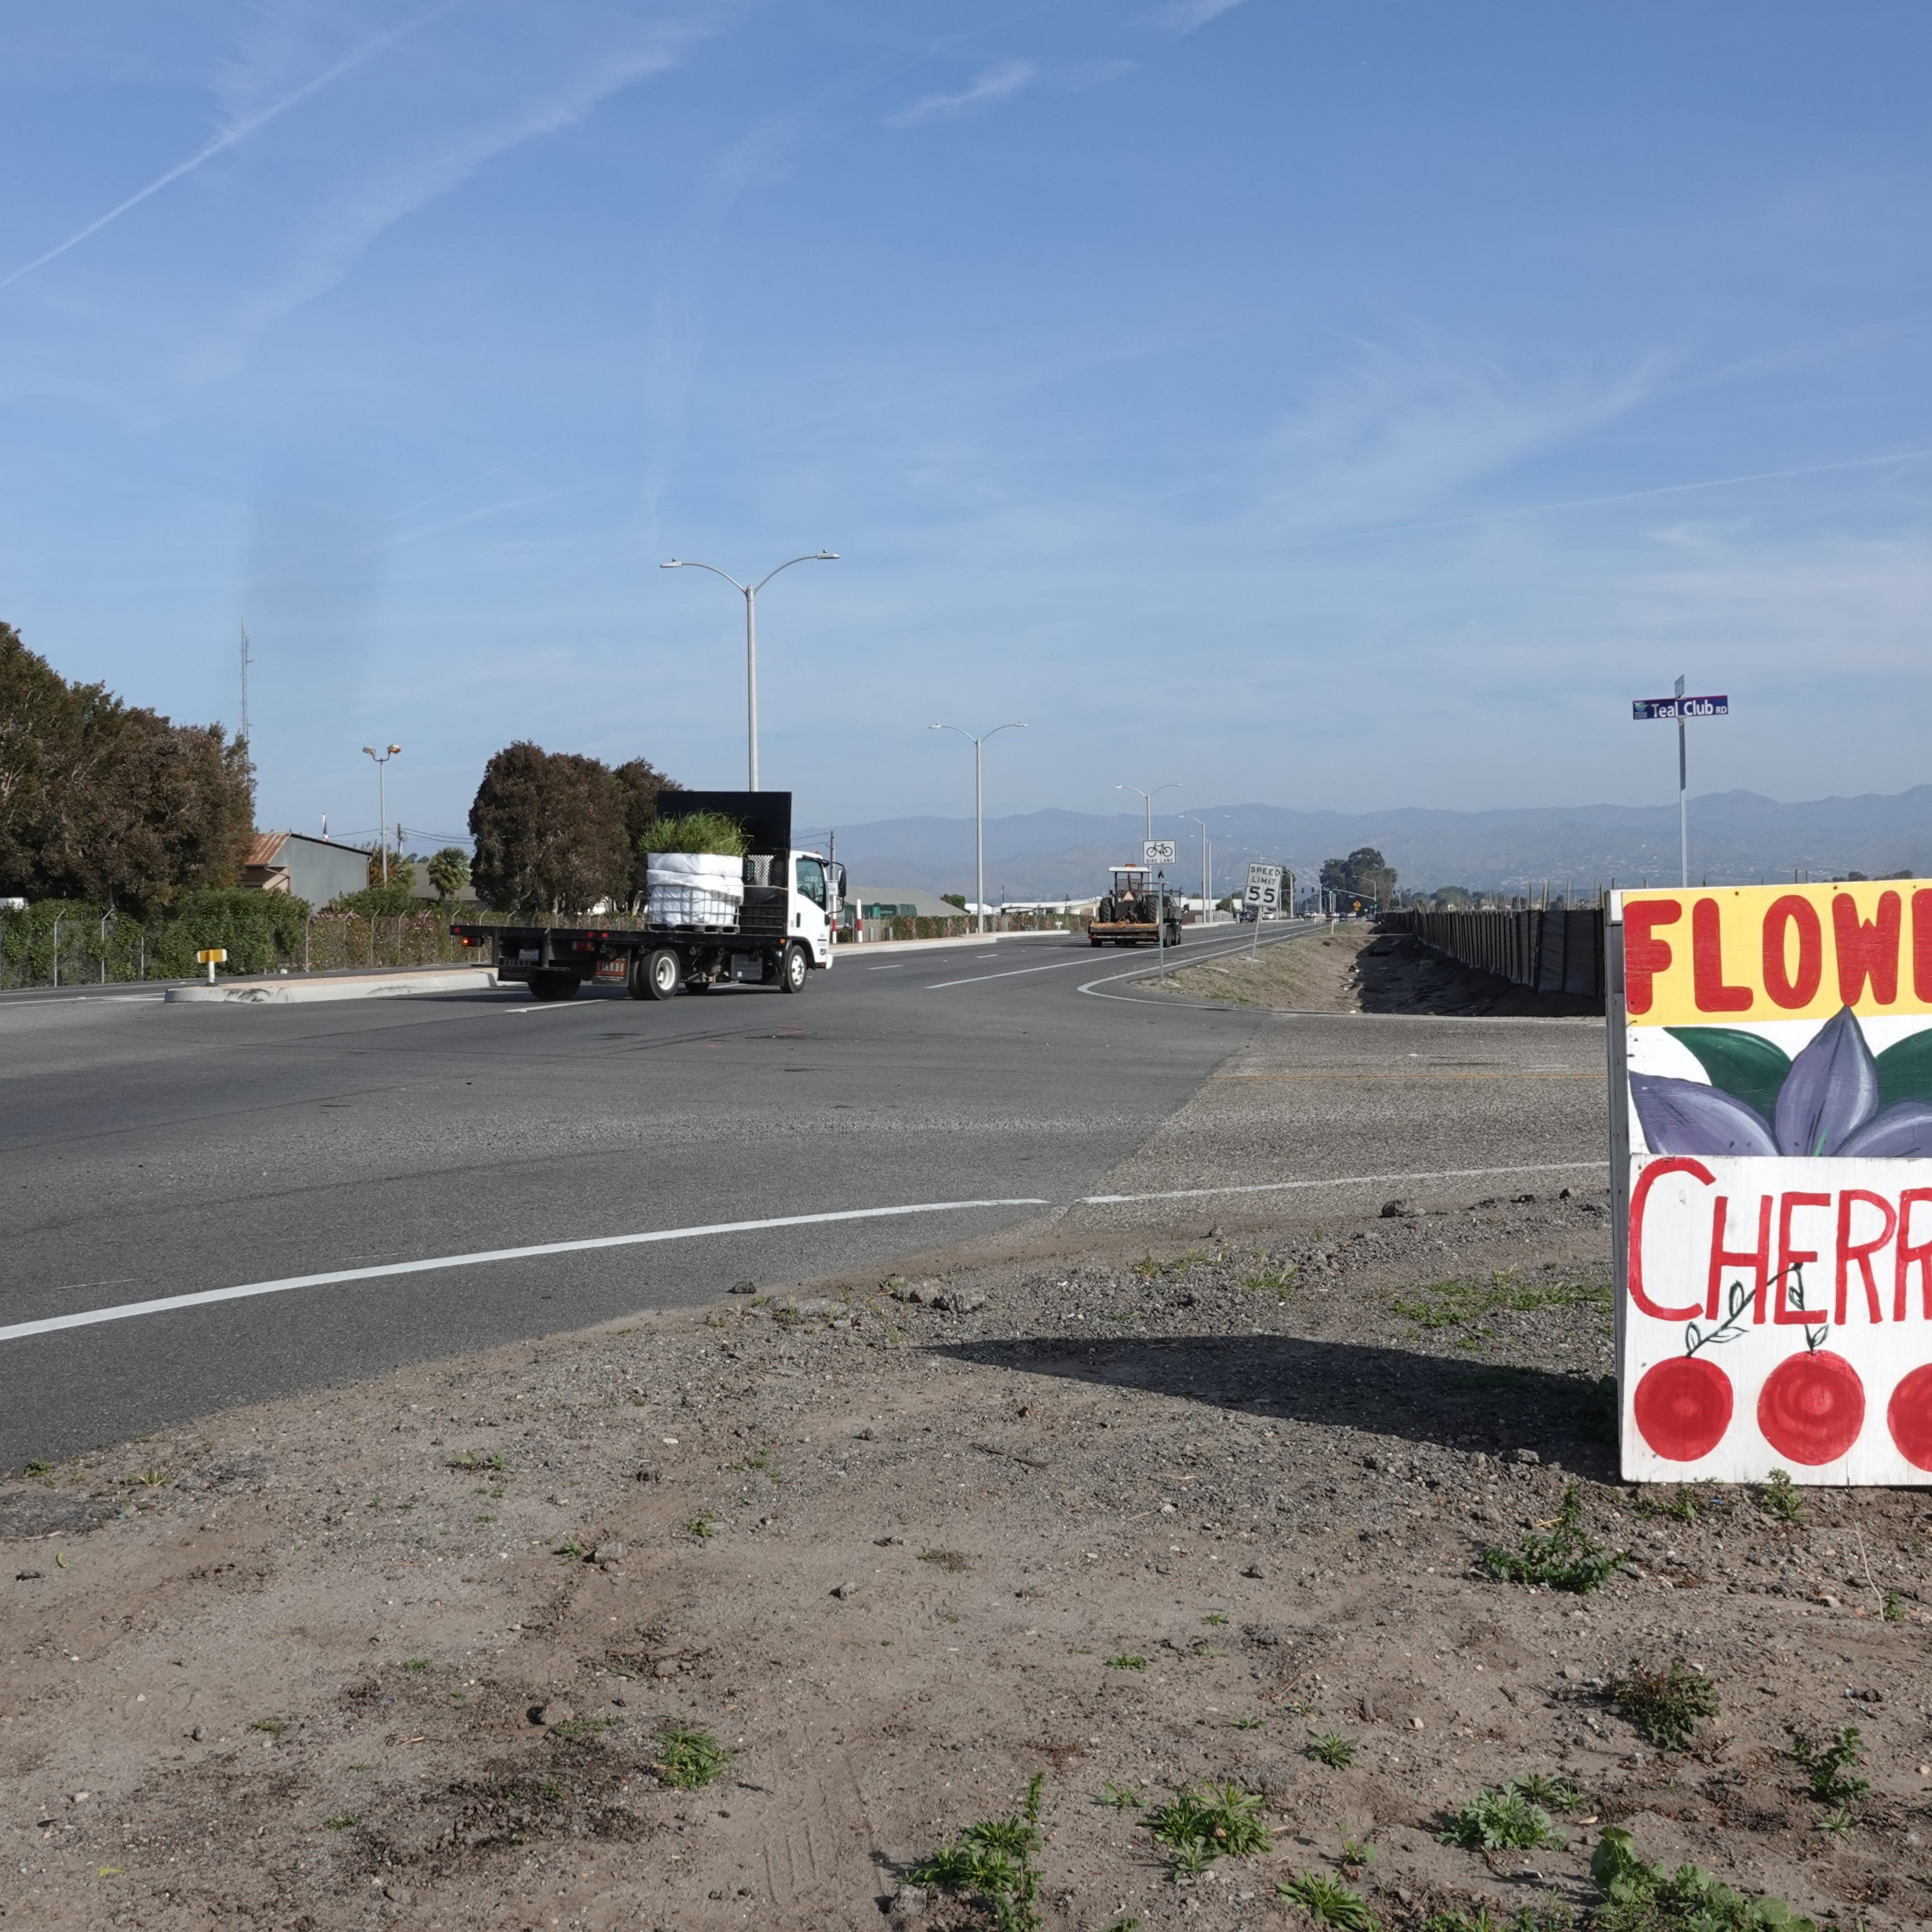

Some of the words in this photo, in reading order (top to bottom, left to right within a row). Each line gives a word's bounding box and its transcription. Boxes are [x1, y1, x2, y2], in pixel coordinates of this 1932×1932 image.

[1651, 701, 1678, 718] Teal
[1683, 699, 1713, 716] Club
[1716, 705, 1727, 714] RD
[1251, 866, 1280, 876] SPEED
[1252, 876, 1276, 885] LIMIT
[1248, 886, 1275, 903] 55
[1627, 1156, 1932, 1325] CHERR
